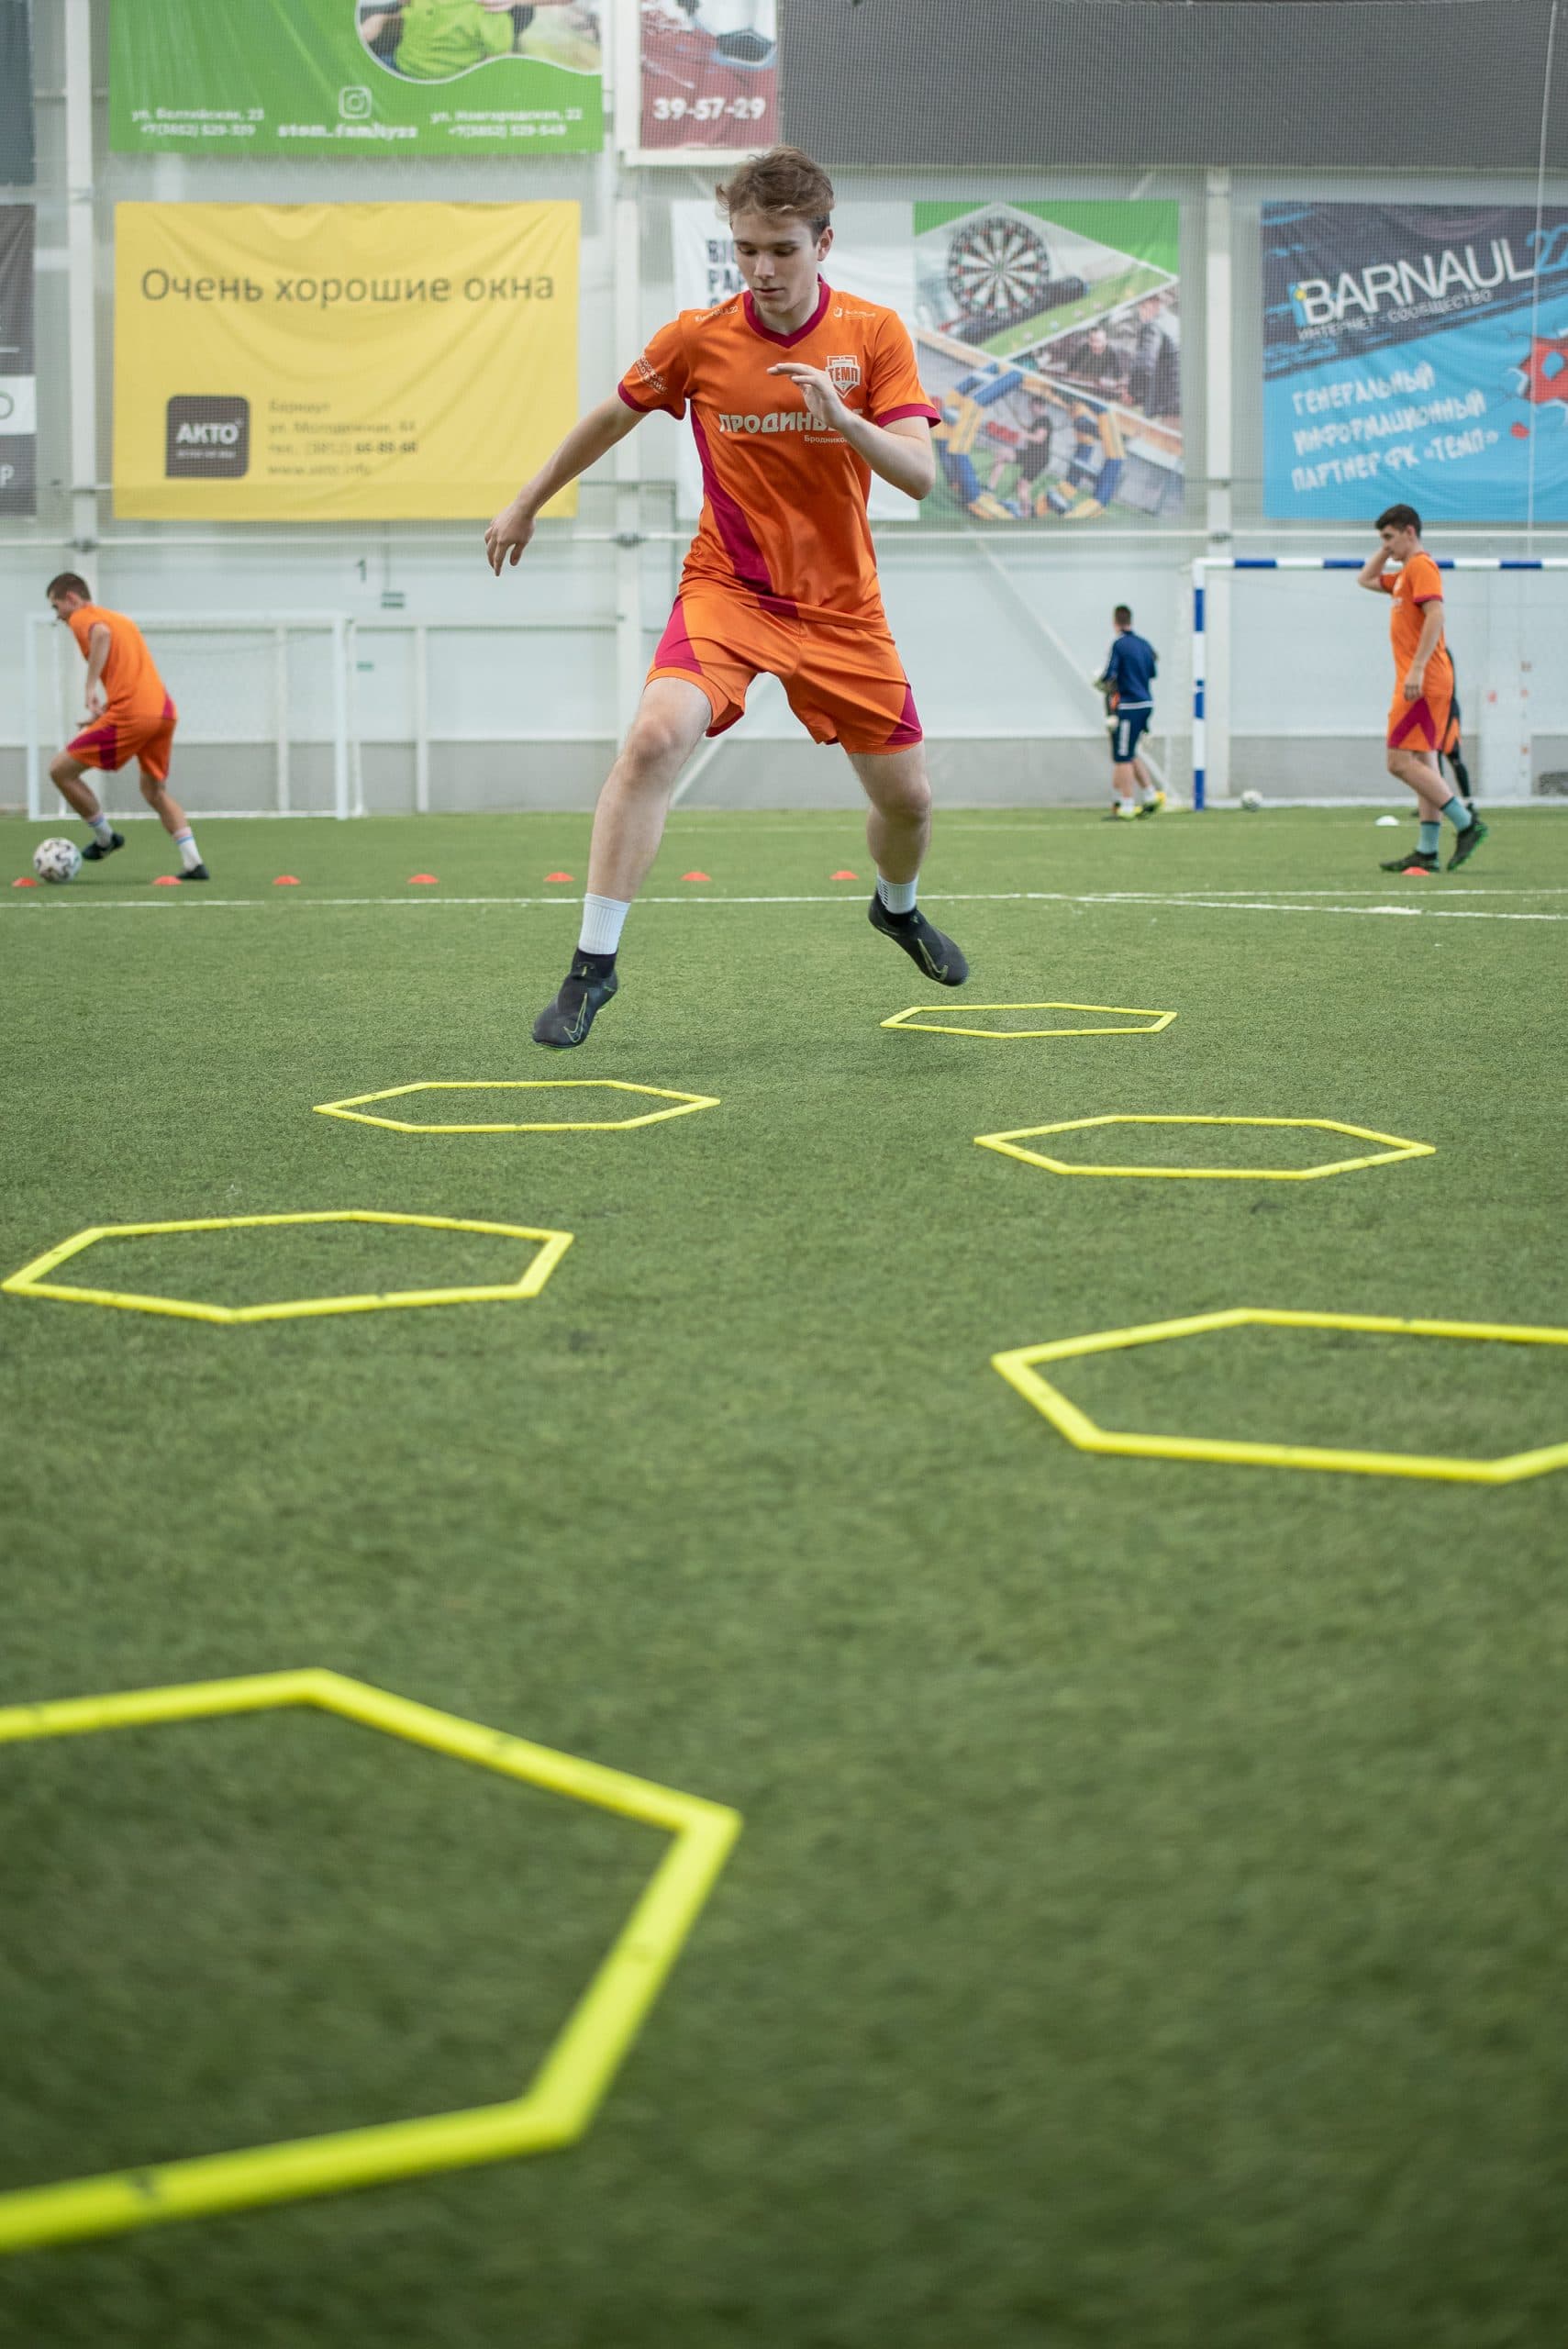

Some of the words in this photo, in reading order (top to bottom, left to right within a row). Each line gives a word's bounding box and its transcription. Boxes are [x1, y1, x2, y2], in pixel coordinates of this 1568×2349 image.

[653, 96, 766, 121] 39-57-29
[141, 268, 263, 302] Очень
[274, 273, 452, 309] хорошие
[463, 274, 554, 300] окна
[828, 366, 859, 383] ТЕМП
[1291, 359, 1436, 417] ГЕНЕРАЛЬНЫЙ
[804, 434, 848, 445] Броднико
[1292, 388, 1487, 456] ИНФОРМАЦИОННЫЙ
[1291, 451, 1381, 492] ПАРТНЕР
[1384, 443, 1420, 472] ФК
